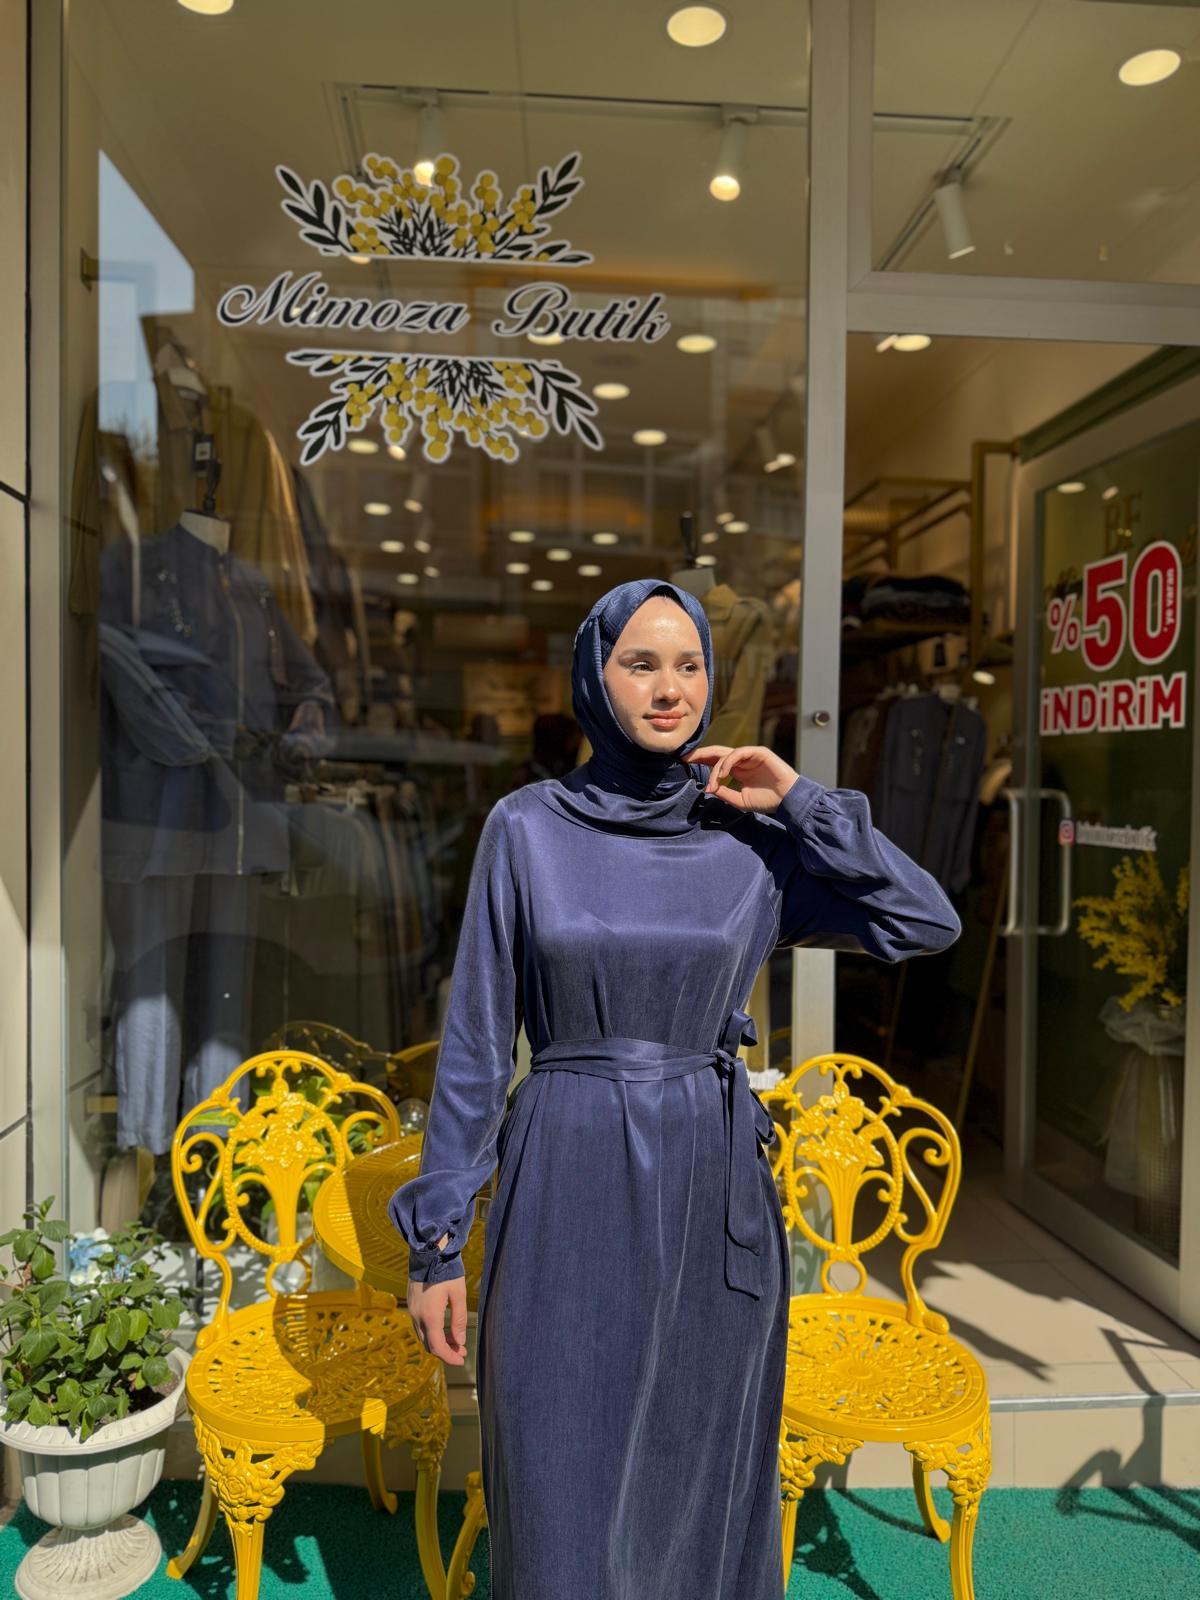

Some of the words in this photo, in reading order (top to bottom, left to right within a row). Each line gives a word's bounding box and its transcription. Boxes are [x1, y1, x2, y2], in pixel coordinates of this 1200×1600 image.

[217, 271, 470, 335] Mimoza
[492, 282, 670, 343] Butik
[1048, 541, 1182, 671] %50
